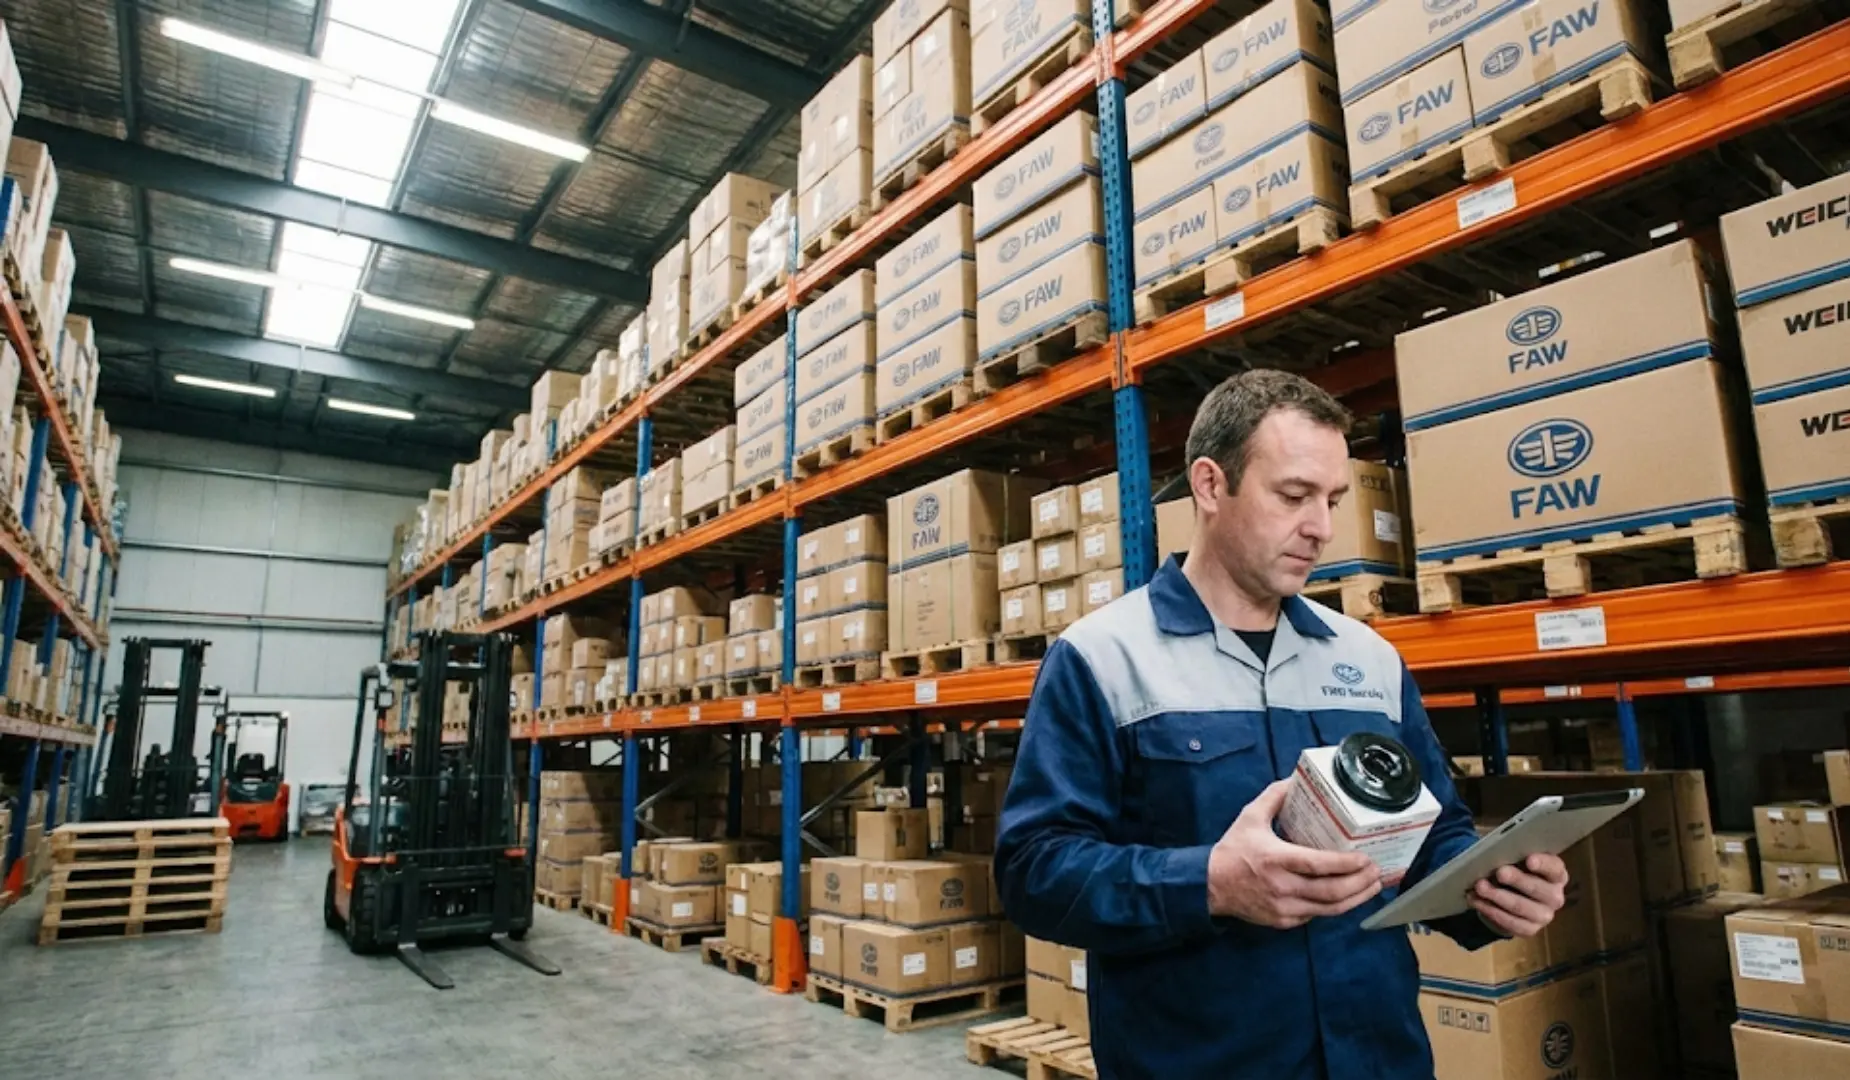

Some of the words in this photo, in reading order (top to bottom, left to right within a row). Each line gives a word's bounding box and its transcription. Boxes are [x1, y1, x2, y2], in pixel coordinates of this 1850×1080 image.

[1244, 18, 1287, 56] FAW
[1529, 2, 1599, 56] FAW
[1160, 75, 1195, 108] FAW
[1397, 79, 1454, 125] FAW
[1019, 146, 1054, 184] FAW
[1256, 161, 1300, 198] FAW
[1024, 210, 1062, 247] FAW
[1168, 211, 1207, 244] FAW
[1767, 194, 1850, 238] WEIC
[1024, 275, 1063, 311] FAW
[1784, 301, 1850, 335] WEI
[1508, 340, 1567, 374] FAW
[1510, 474, 1600, 519] FAW
[912, 526, 941, 550] FAW
